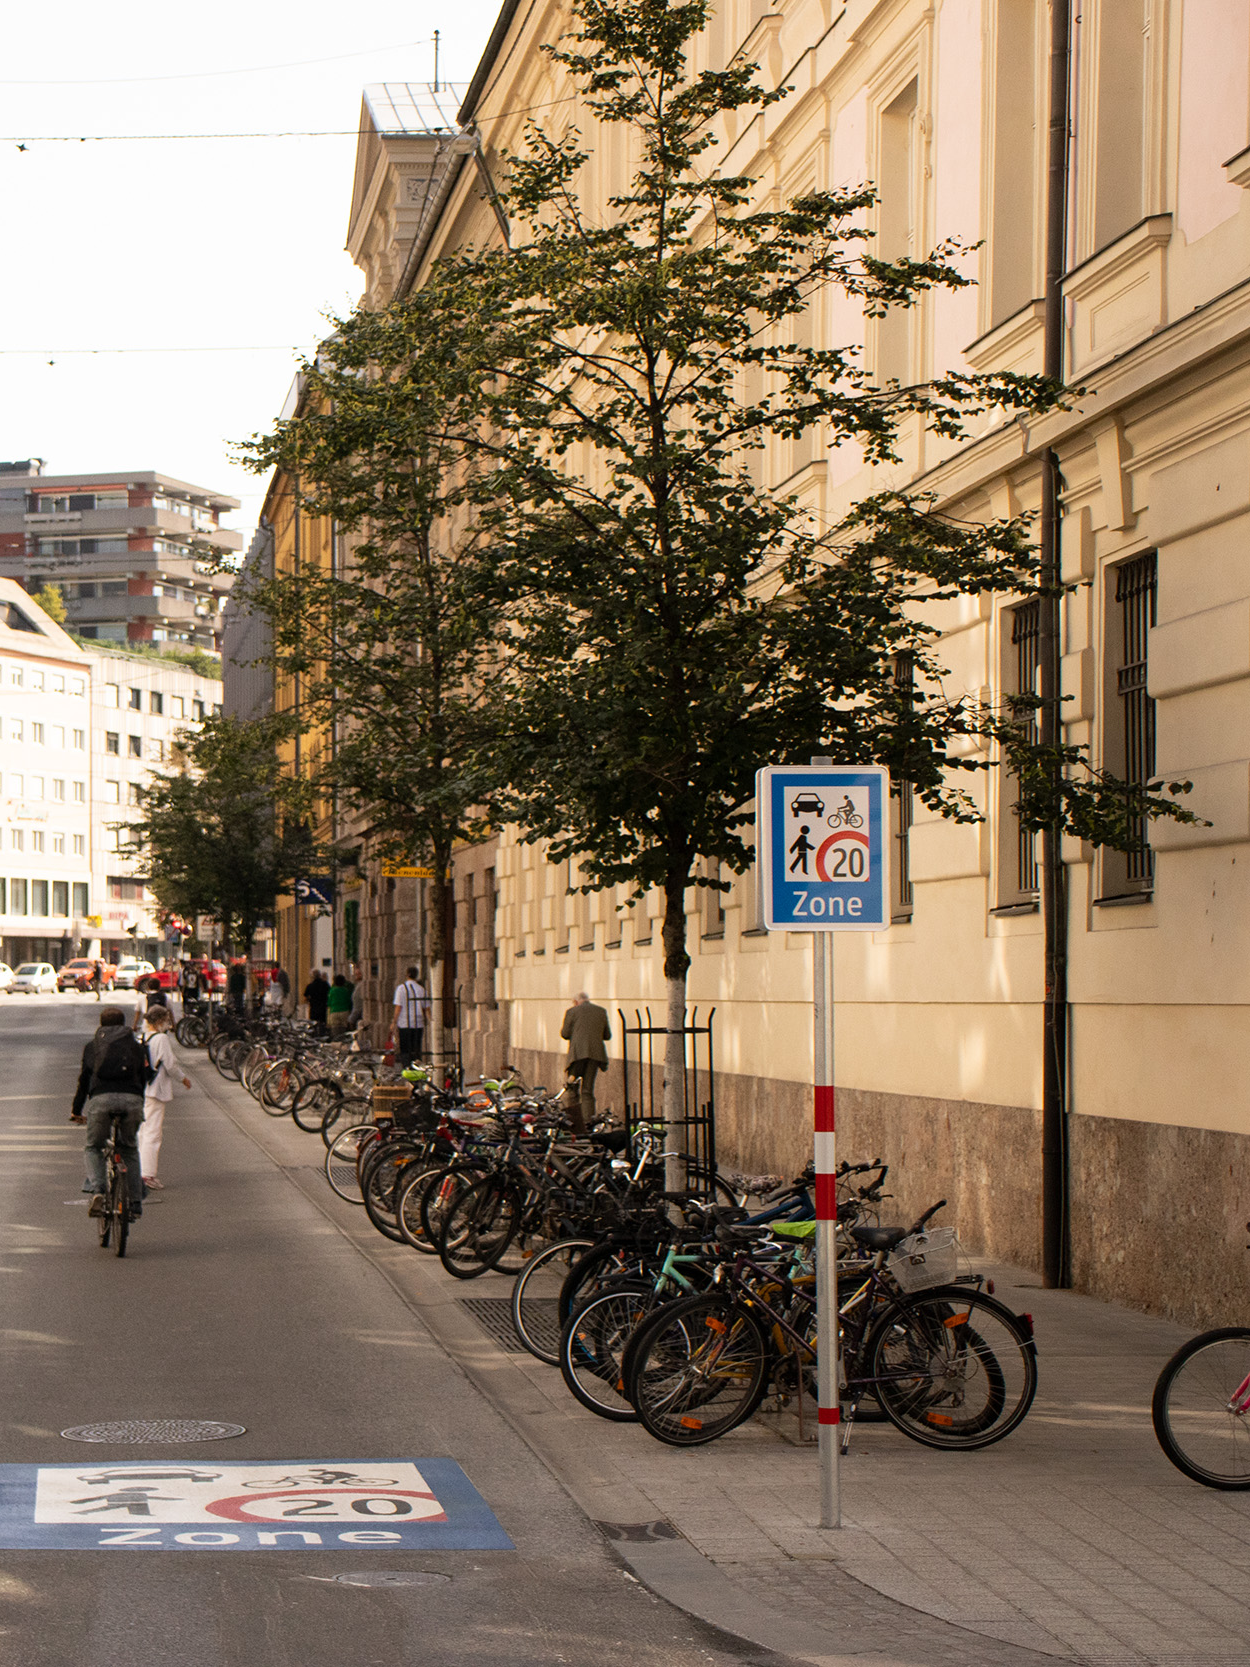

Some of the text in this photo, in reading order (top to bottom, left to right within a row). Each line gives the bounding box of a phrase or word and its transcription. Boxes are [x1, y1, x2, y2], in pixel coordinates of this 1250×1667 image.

[832, 847, 865, 878] 20
[792, 890, 863, 917] Zone
[277, 1498, 413, 1517] 20
[98, 1527, 402, 1546] Zone
